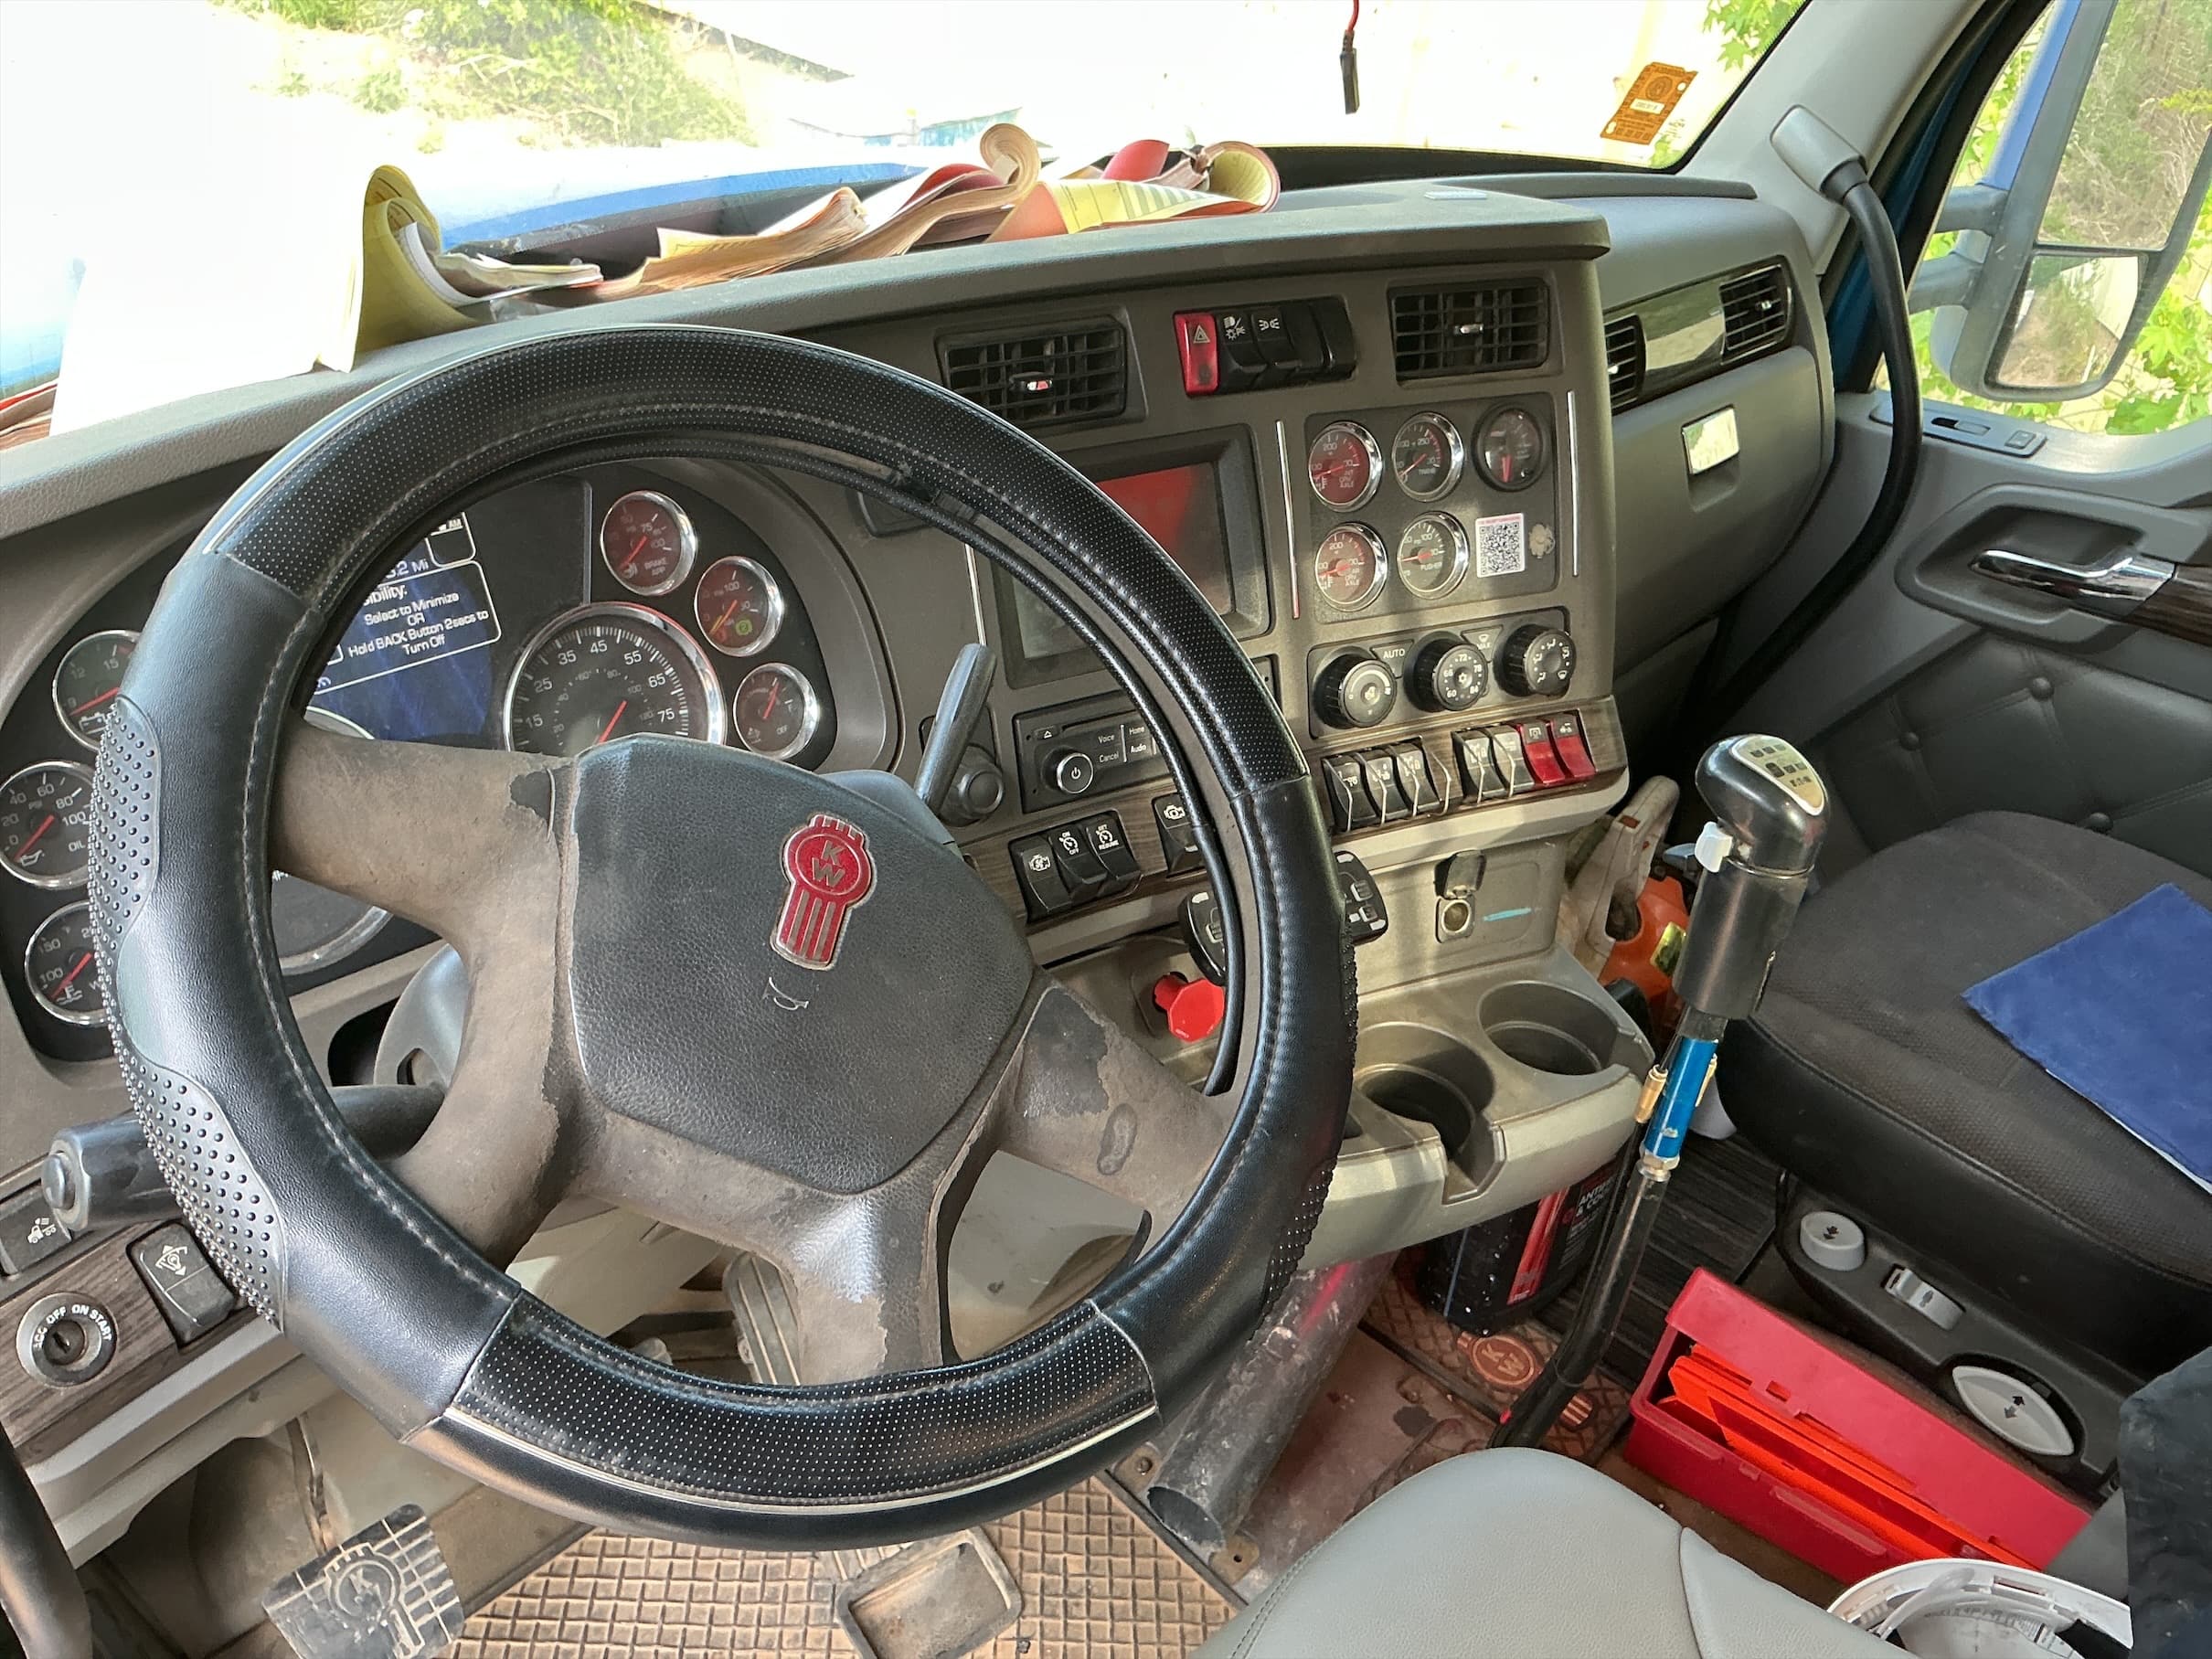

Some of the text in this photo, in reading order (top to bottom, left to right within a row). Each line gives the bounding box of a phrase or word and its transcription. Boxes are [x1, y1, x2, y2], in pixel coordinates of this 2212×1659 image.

[640, 522, 654, 533] 75
[1329, 541, 1345, 550] 200
[411, 558, 430, 574] Mi
[724, 580, 740, 592] 100
[364, 591, 460, 626] Select to Minimize
[407, 612, 426, 627] OR
[348, 610, 490, 658] Hold BACK Button 2secs to
[402, 634, 446, 656] Turn Off
[590, 639, 608, 654] 45
[558, 650, 578, 666] 35
[623, 650, 643, 666] 55
[1382, 648, 1407, 660] AUTO
[1459, 654, 1468, 662] 72
[102, 657, 120, 671] 15
[533, 676, 554, 694] 25
[647, 674, 667, 689] 65
[1446, 689, 1458, 698] 60
[526, 713, 544, 729] 15
[657, 707, 675, 723] 75
[1098, 734, 1115, 744] Voice
[1130, 742, 1147, 754] Audio
[1099, 750, 1120, 763] Cancel
[37, 782, 55, 797] 60
[9, 792, 27, 805] 40
[55, 795, 74, 810] 80
[62, 811, 87, 827] 100
[8, 834, 19, 845] 0
[69, 840, 87, 852] OIL
[821, 839, 845, 867] K
[810, 856, 846, 888] W
[39, 967, 65, 983] 100
[46, 1306, 68, 1324] OFF
[71, 1303, 90, 1316] ON
[89, 1308, 113, 1342] START
[1481, 1343, 1505, 1364] K
[1496, 1352, 1524, 1377] W
